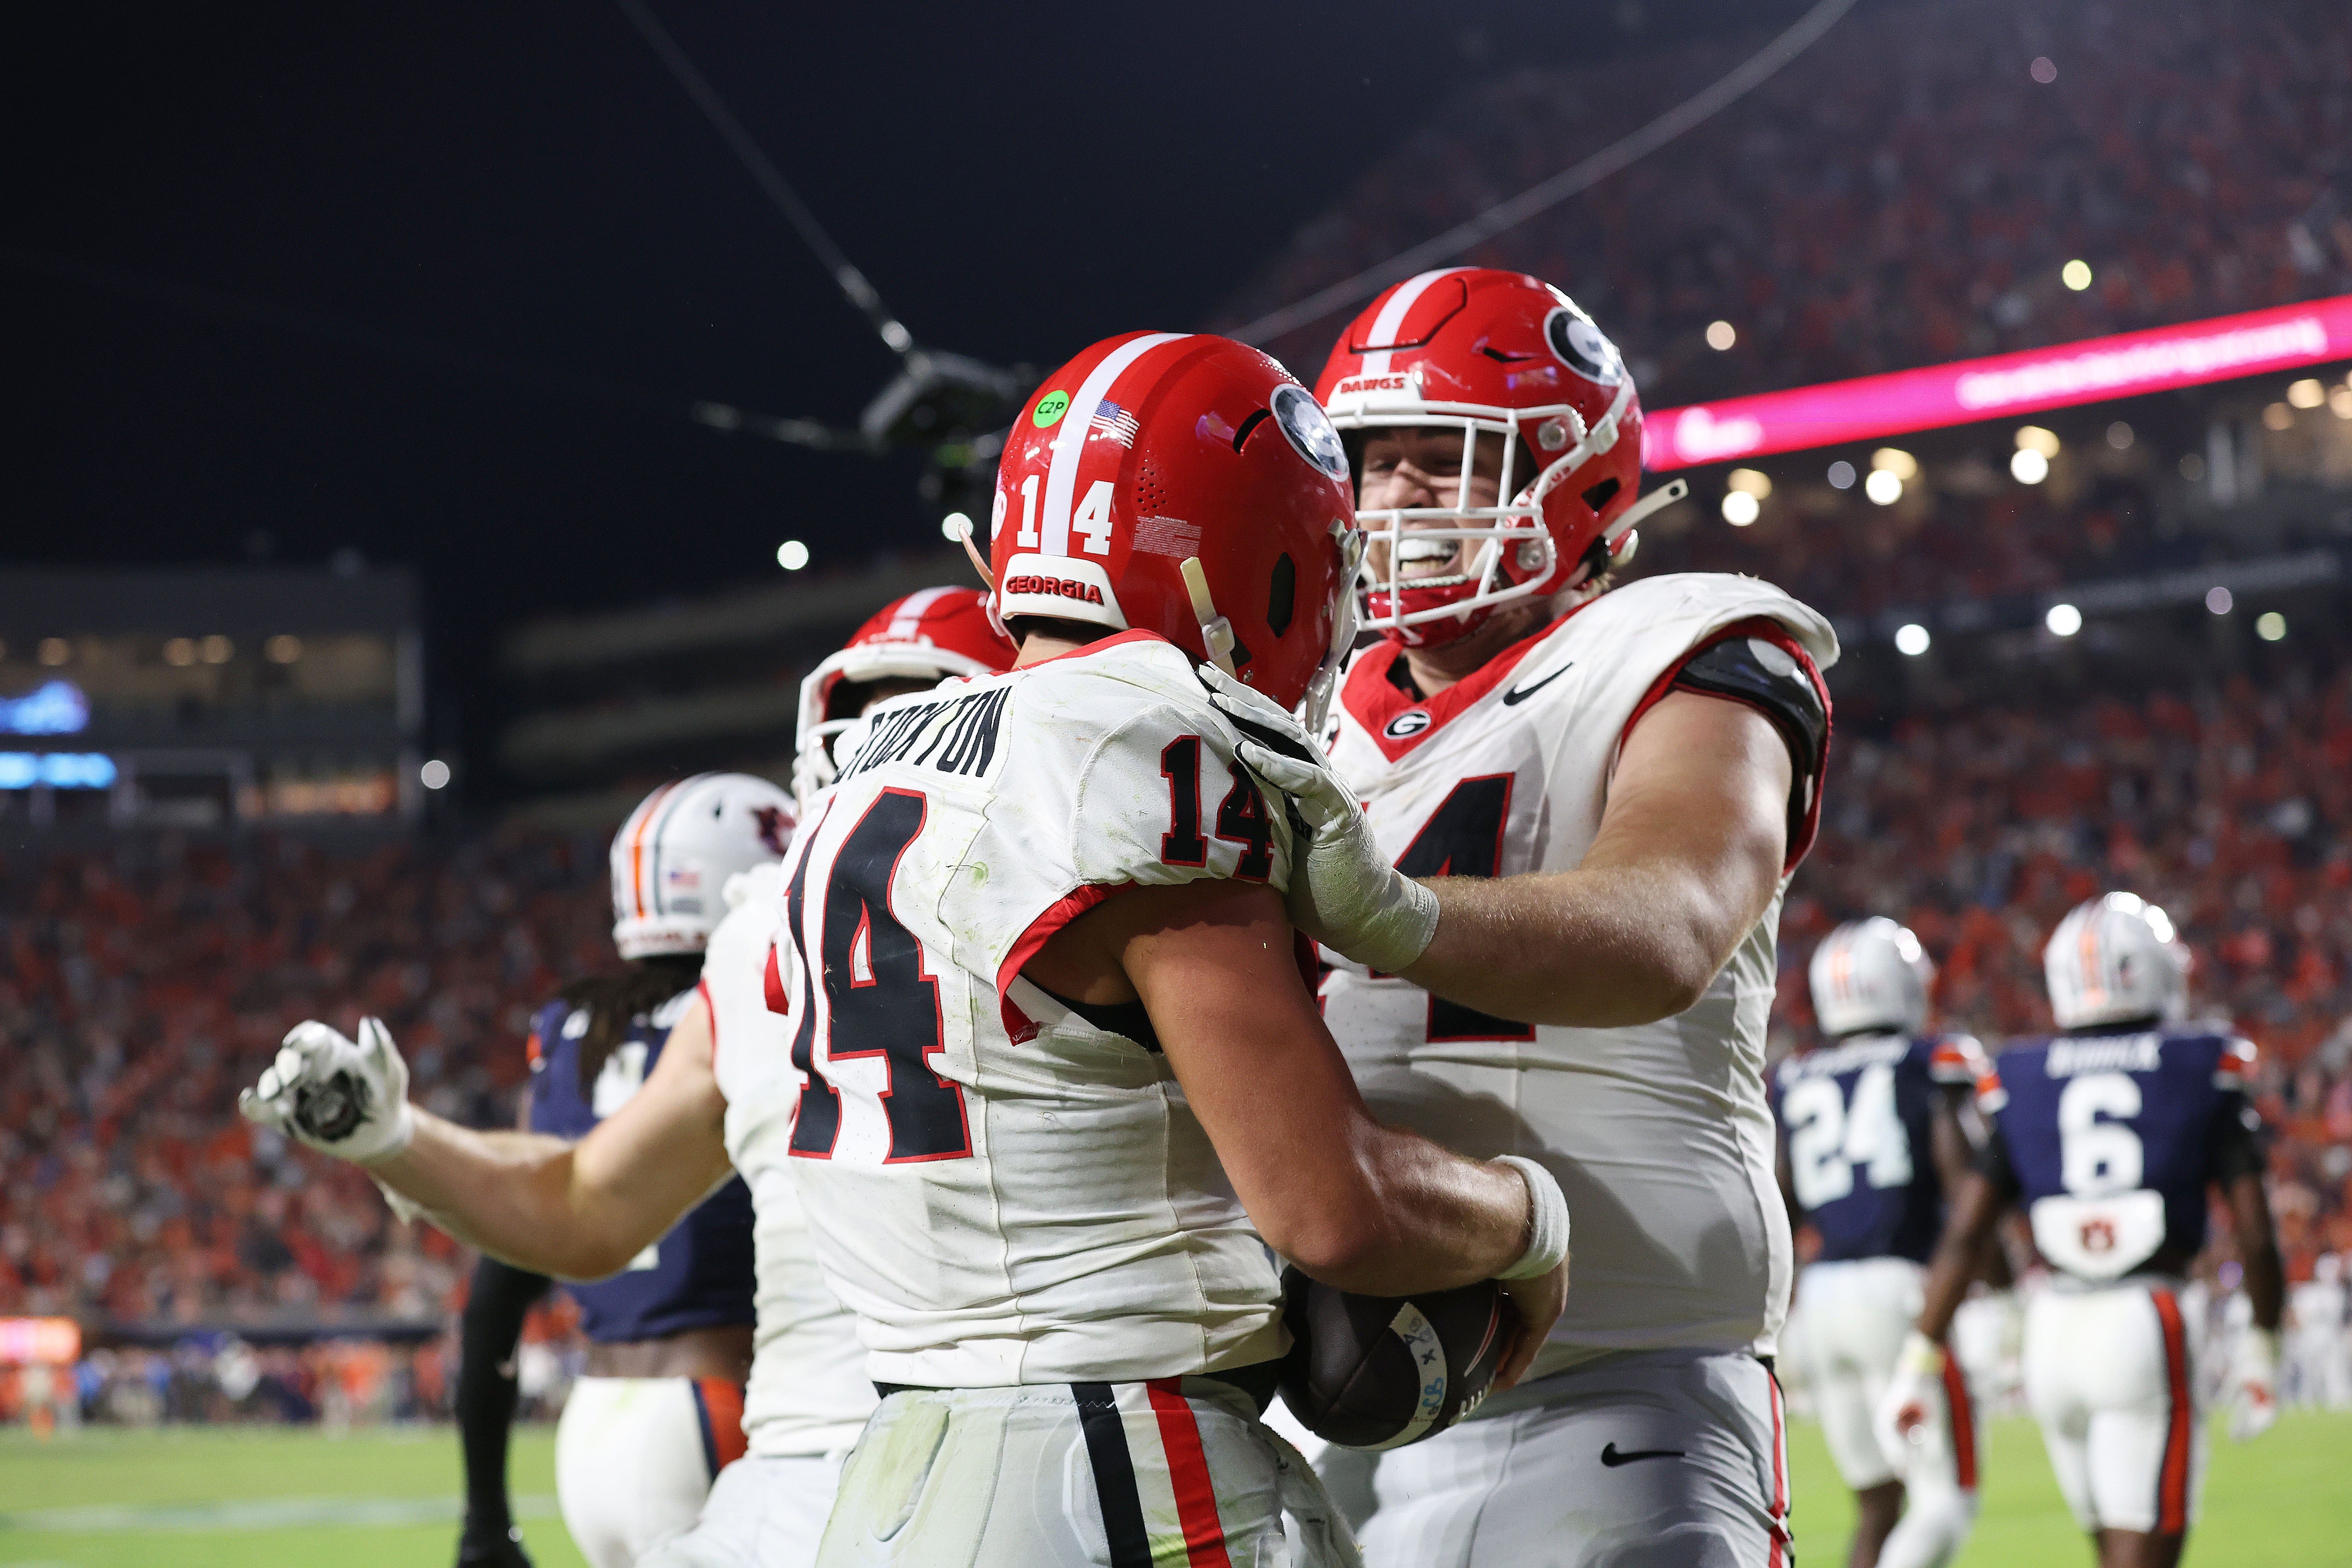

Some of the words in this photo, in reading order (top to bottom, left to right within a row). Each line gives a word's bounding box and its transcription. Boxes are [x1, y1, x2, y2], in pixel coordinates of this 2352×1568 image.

[1038, 402, 1065, 414] C2P
[1341, 377, 1405, 393] DAWGS
[1006, 575, 1104, 606] GEORGIA
[831, 686, 1013, 784] STOCKTON
[1160, 734, 1274, 883] 14
[784, 786, 973, 1164] 14
[1781, 1062, 1914, 1211] 24
[2059, 1072, 2144, 1195] 6
